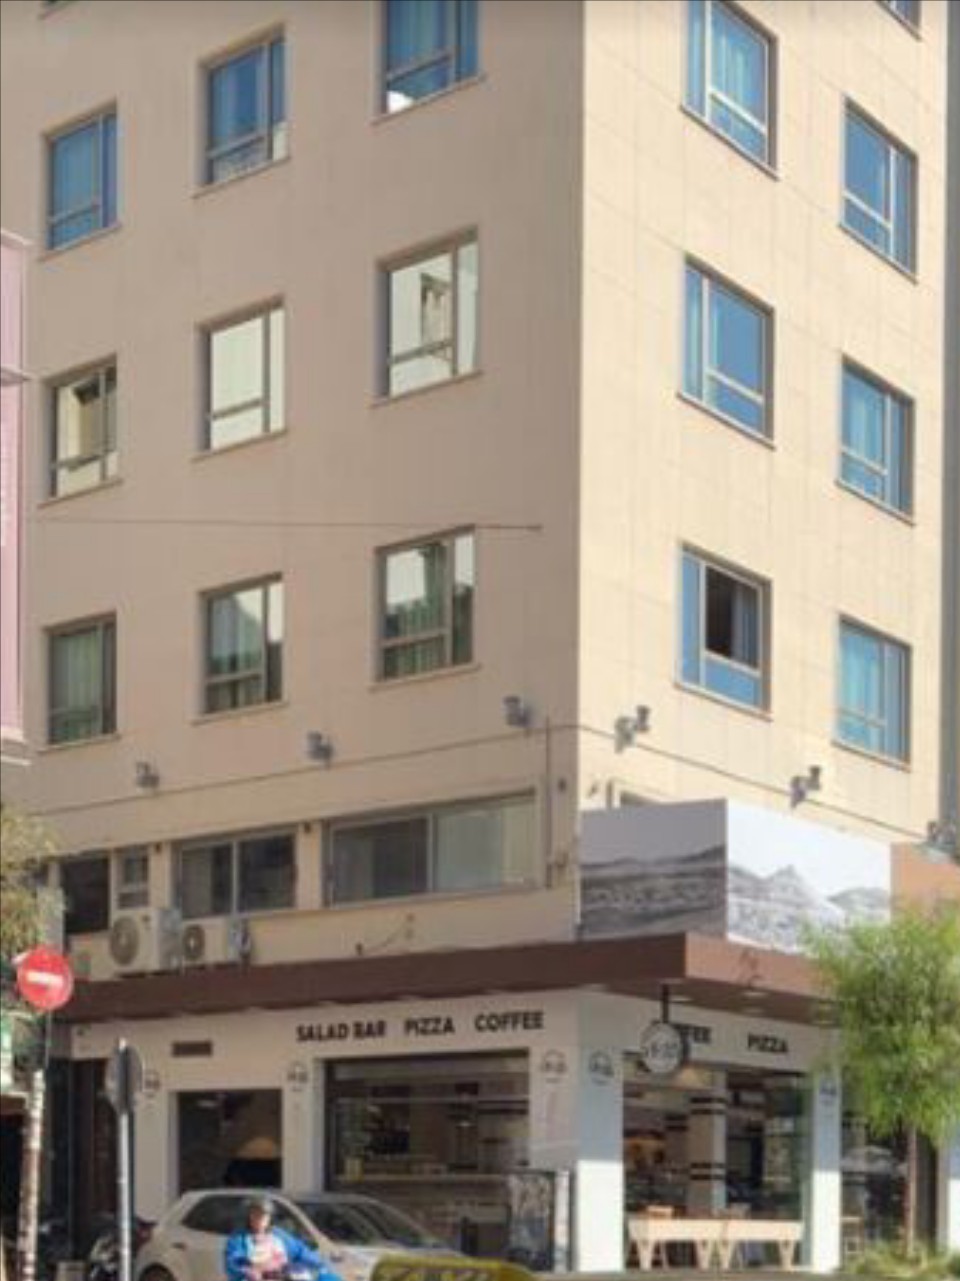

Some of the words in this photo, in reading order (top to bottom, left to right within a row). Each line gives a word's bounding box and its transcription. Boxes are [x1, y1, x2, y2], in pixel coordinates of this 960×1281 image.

[296, 1023, 349, 1043] SALAD
[352, 1020, 387, 1039] BAR
[404, 1017, 456, 1036] PIZZA
[474, 1011, 546, 1033] COFFEE
